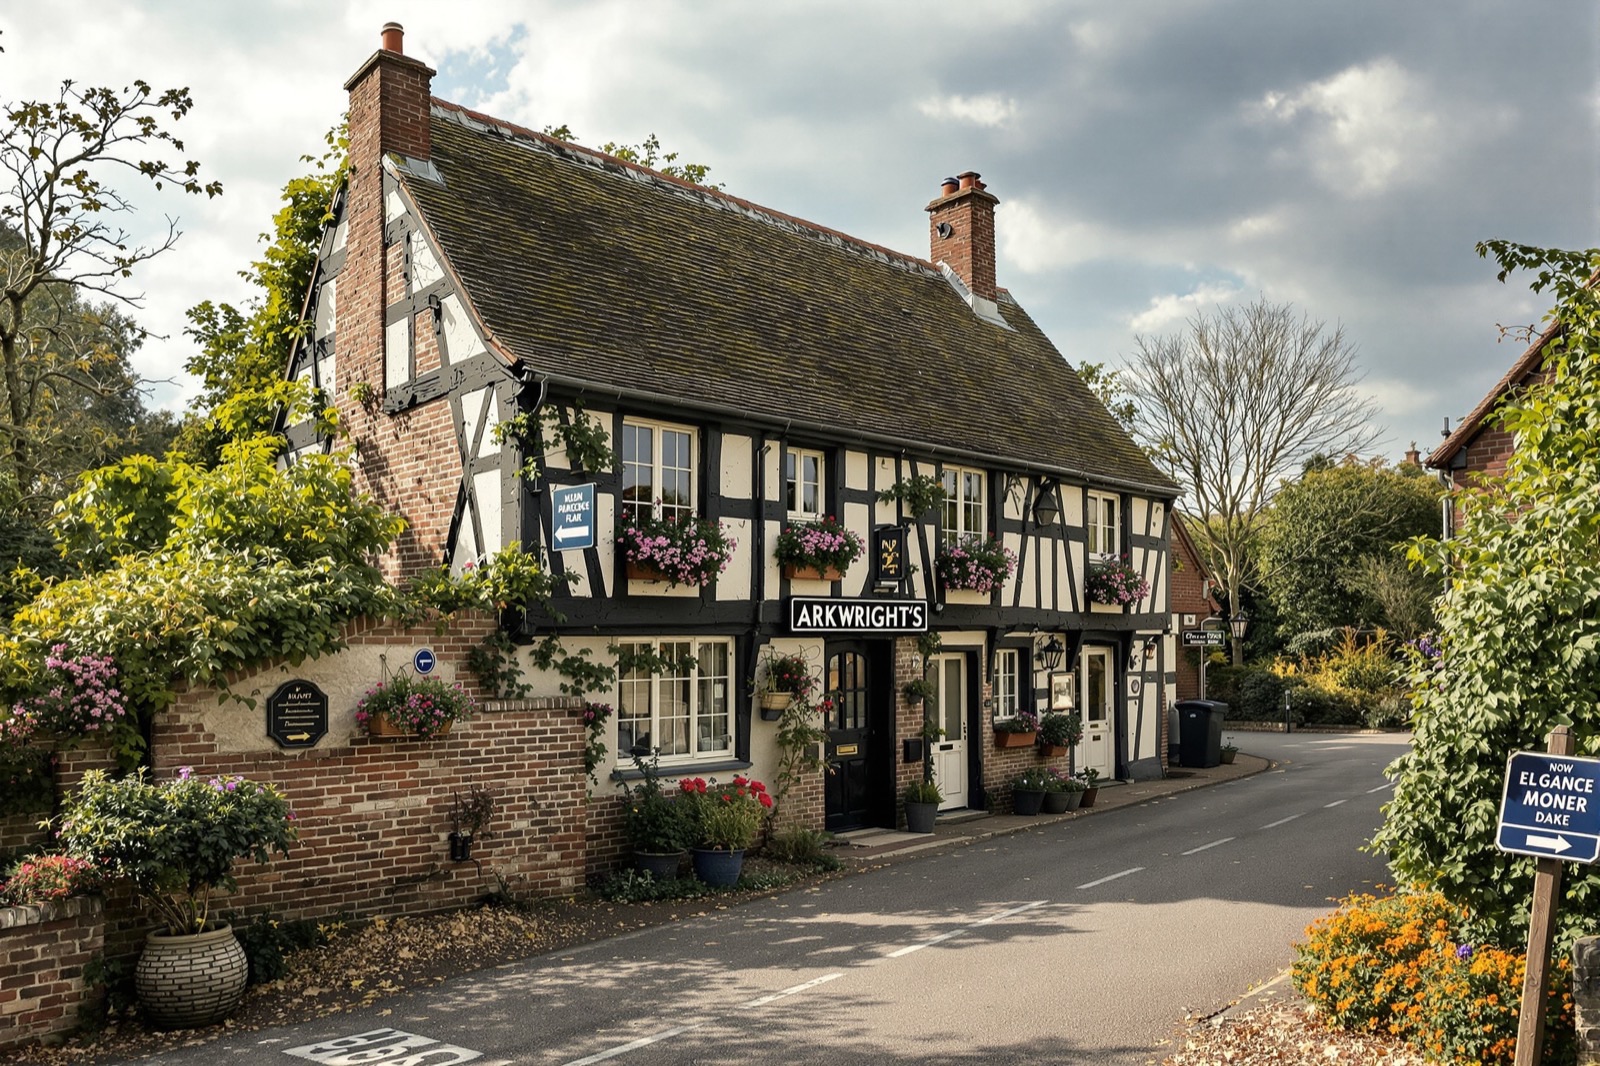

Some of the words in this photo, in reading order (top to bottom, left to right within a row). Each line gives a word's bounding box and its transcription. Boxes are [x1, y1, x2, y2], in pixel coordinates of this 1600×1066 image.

[796, 604, 923, 628] ARKWRIGHT'S
[1549, 763, 1574, 774] NOW
[1522, 790, 1588, 813] MONER
[1535, 811, 1571, 826] DAKE
